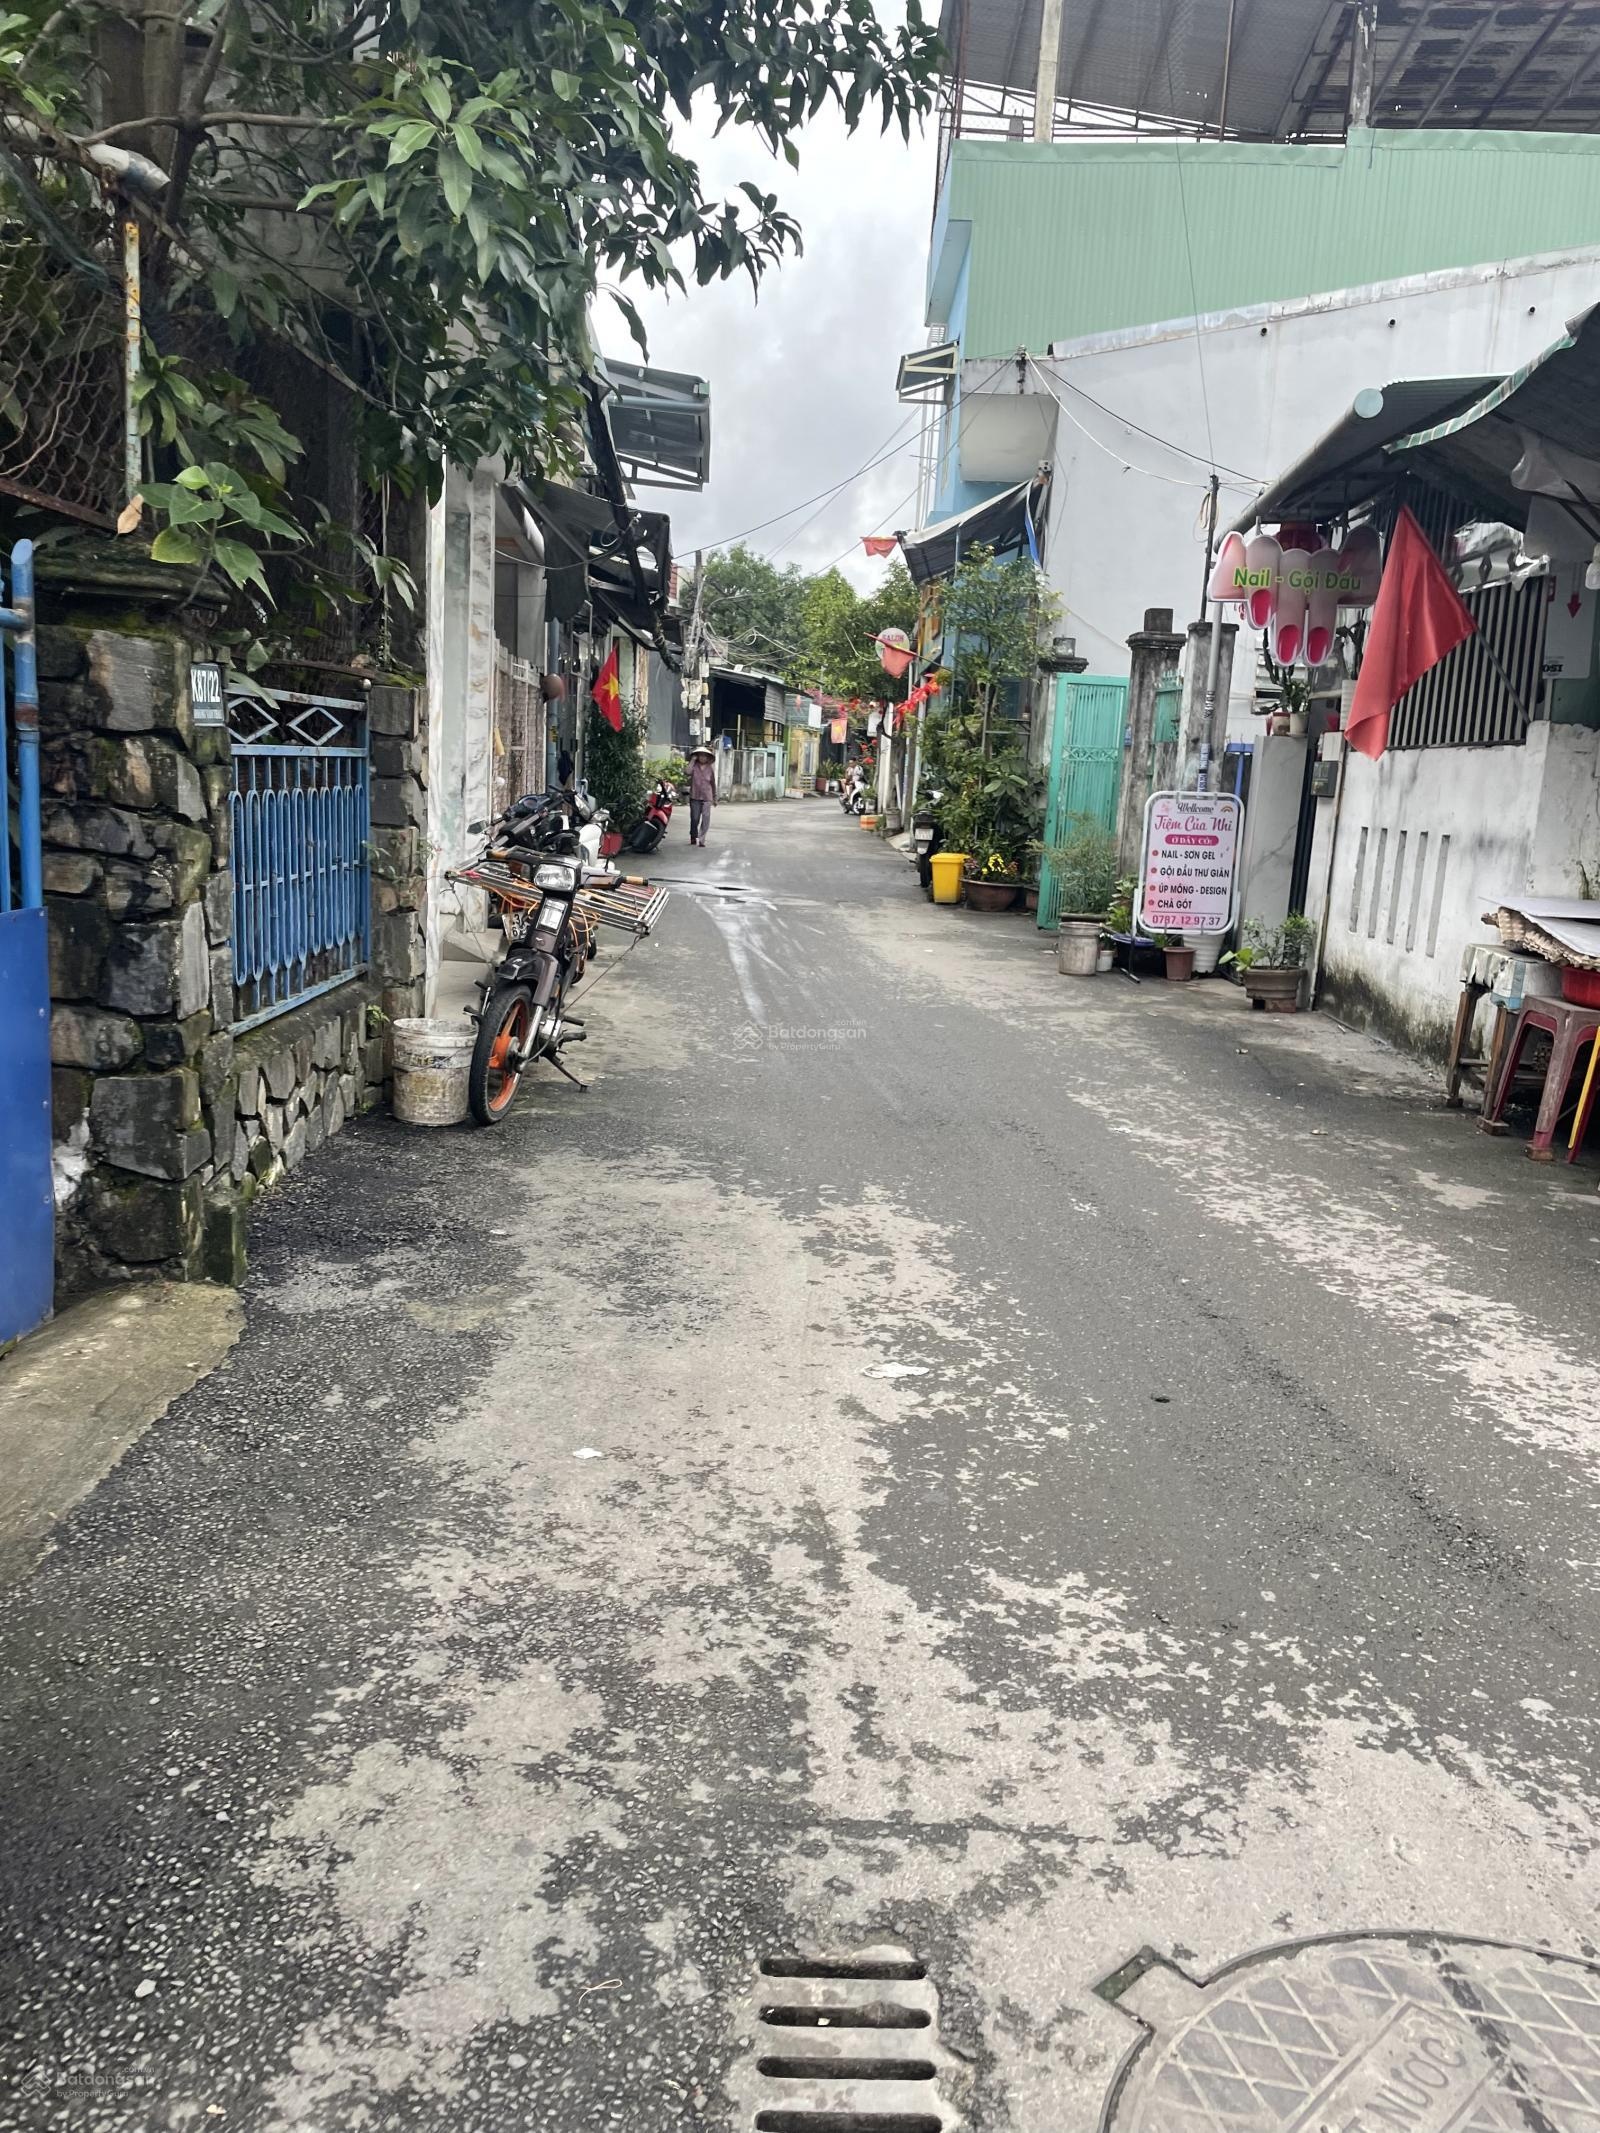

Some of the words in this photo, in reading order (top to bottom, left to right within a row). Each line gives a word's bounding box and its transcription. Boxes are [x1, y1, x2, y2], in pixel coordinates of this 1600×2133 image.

[1234, 568, 1271, 587] Nail
[1289, 569, 1319, 594] Gội
[1161, 850, 1178, 859] NAIL
[1184, 850, 1200, 860] SƠN
[1202, 851, 1215, 860] GEL
[1160, 865, 1175, 878] GỘI
[1195, 868, 1209, 877] THƯ
[1170, 883, 1194, 894] MÓNG
[1200, 886, 1227, 895] DESIGN
